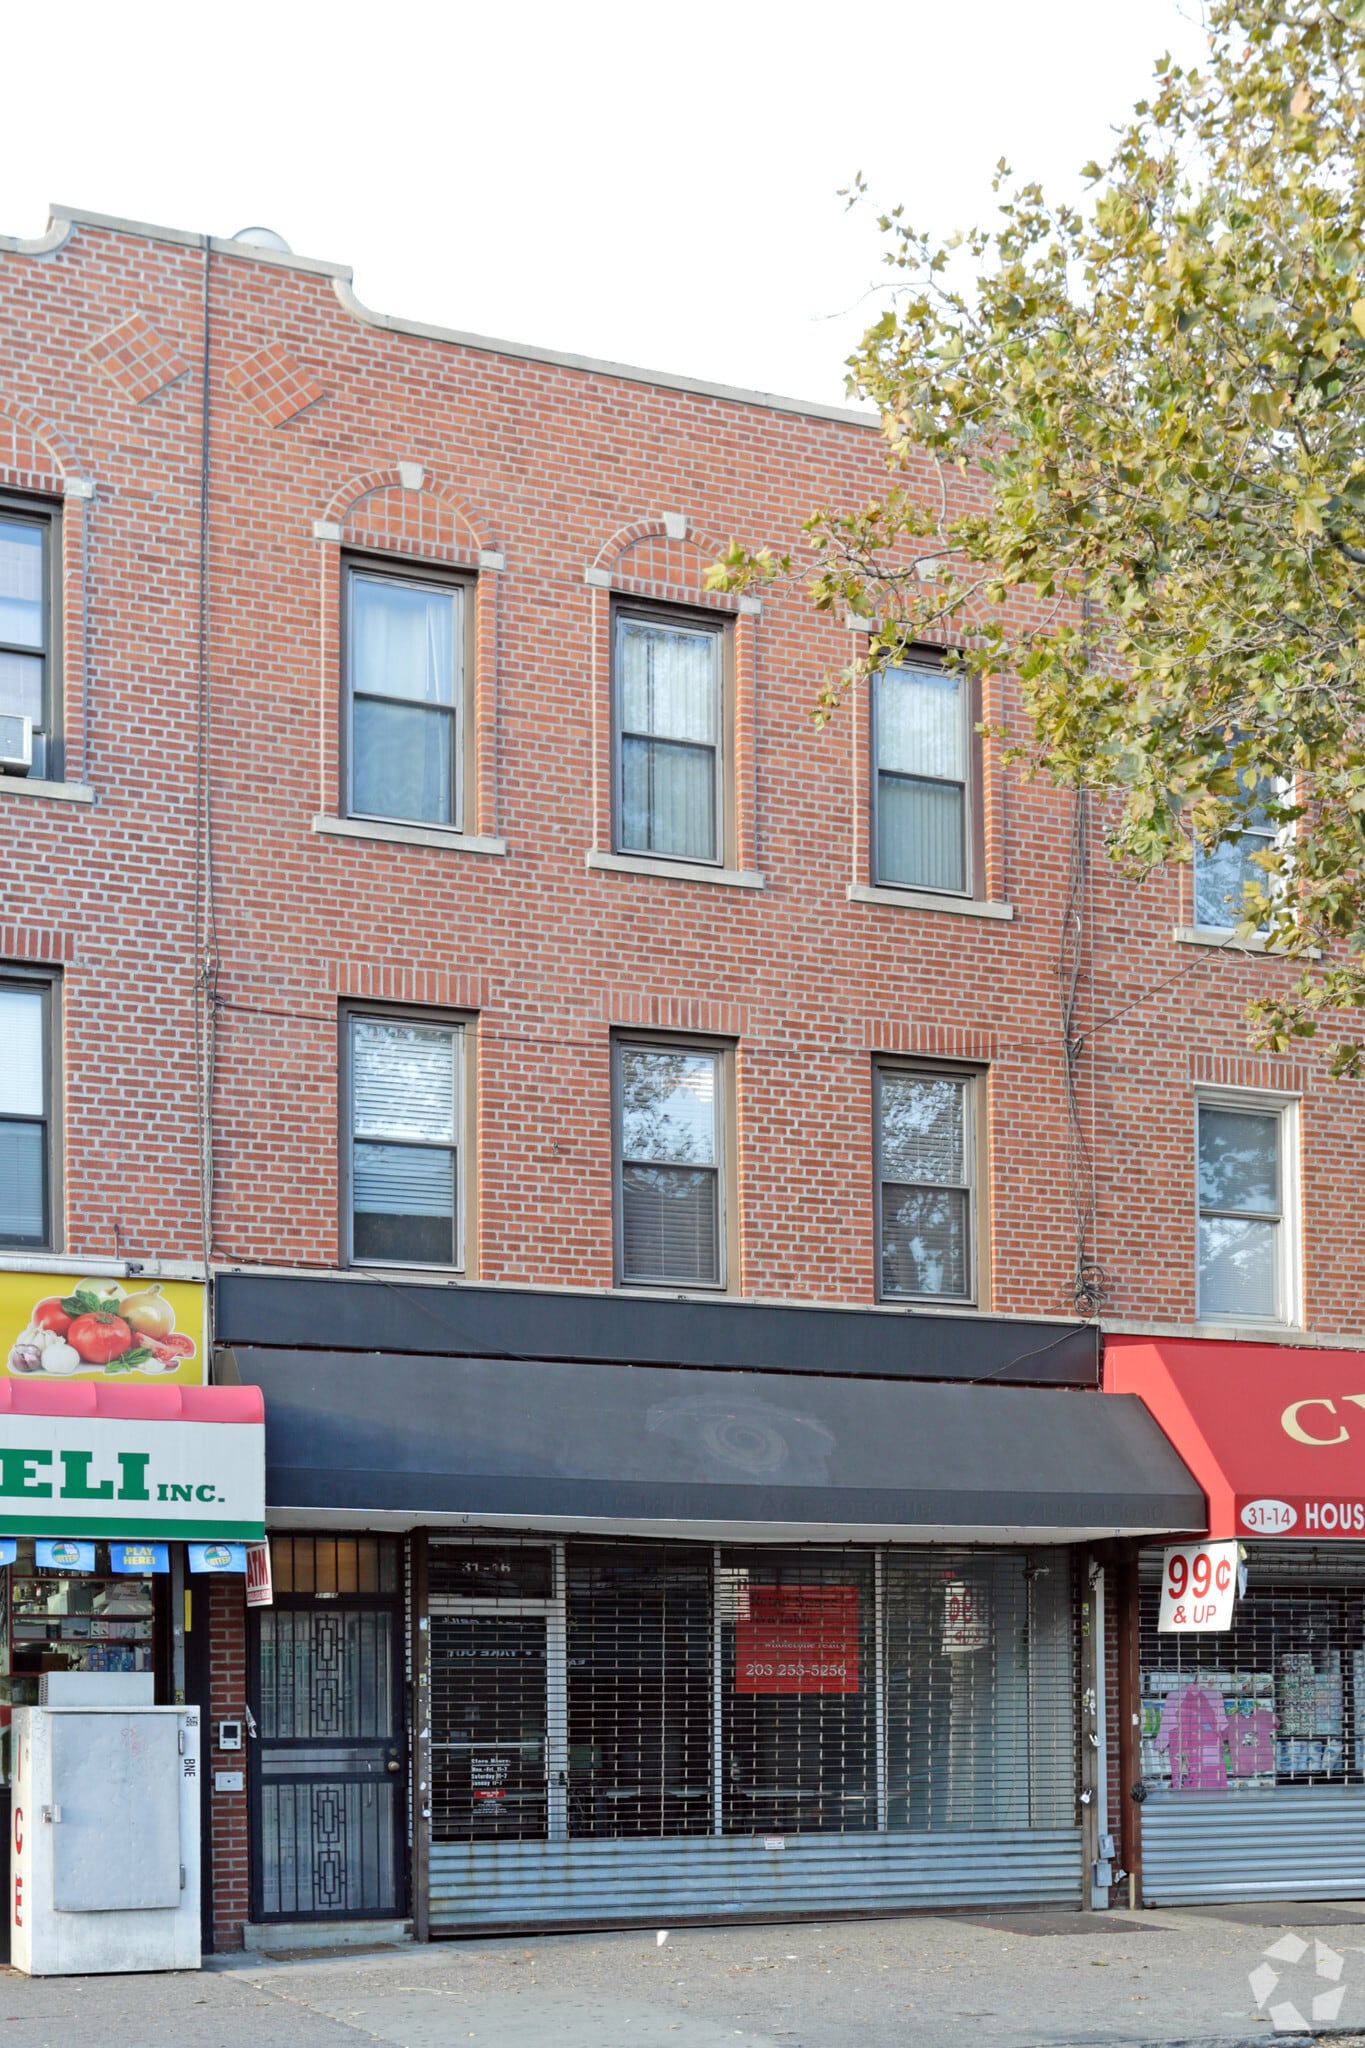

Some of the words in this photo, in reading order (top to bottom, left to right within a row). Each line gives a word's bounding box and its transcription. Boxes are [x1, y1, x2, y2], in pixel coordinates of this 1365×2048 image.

[157, 1483, 226, 1502] INC.
[1247, 1507, 1291, 1526] 31-14
[126, 1546, 153, 1556] PLAY
[247, 1549, 269, 1588] ATM
[1168, 1553, 1232, 1600] 99¢
[1173, 1605, 1187, 1624] &
[1193, 1604, 1217, 1624] UP
[745, 1663, 773, 1676] 203
[184, 1758, 196, 1777] BNE
